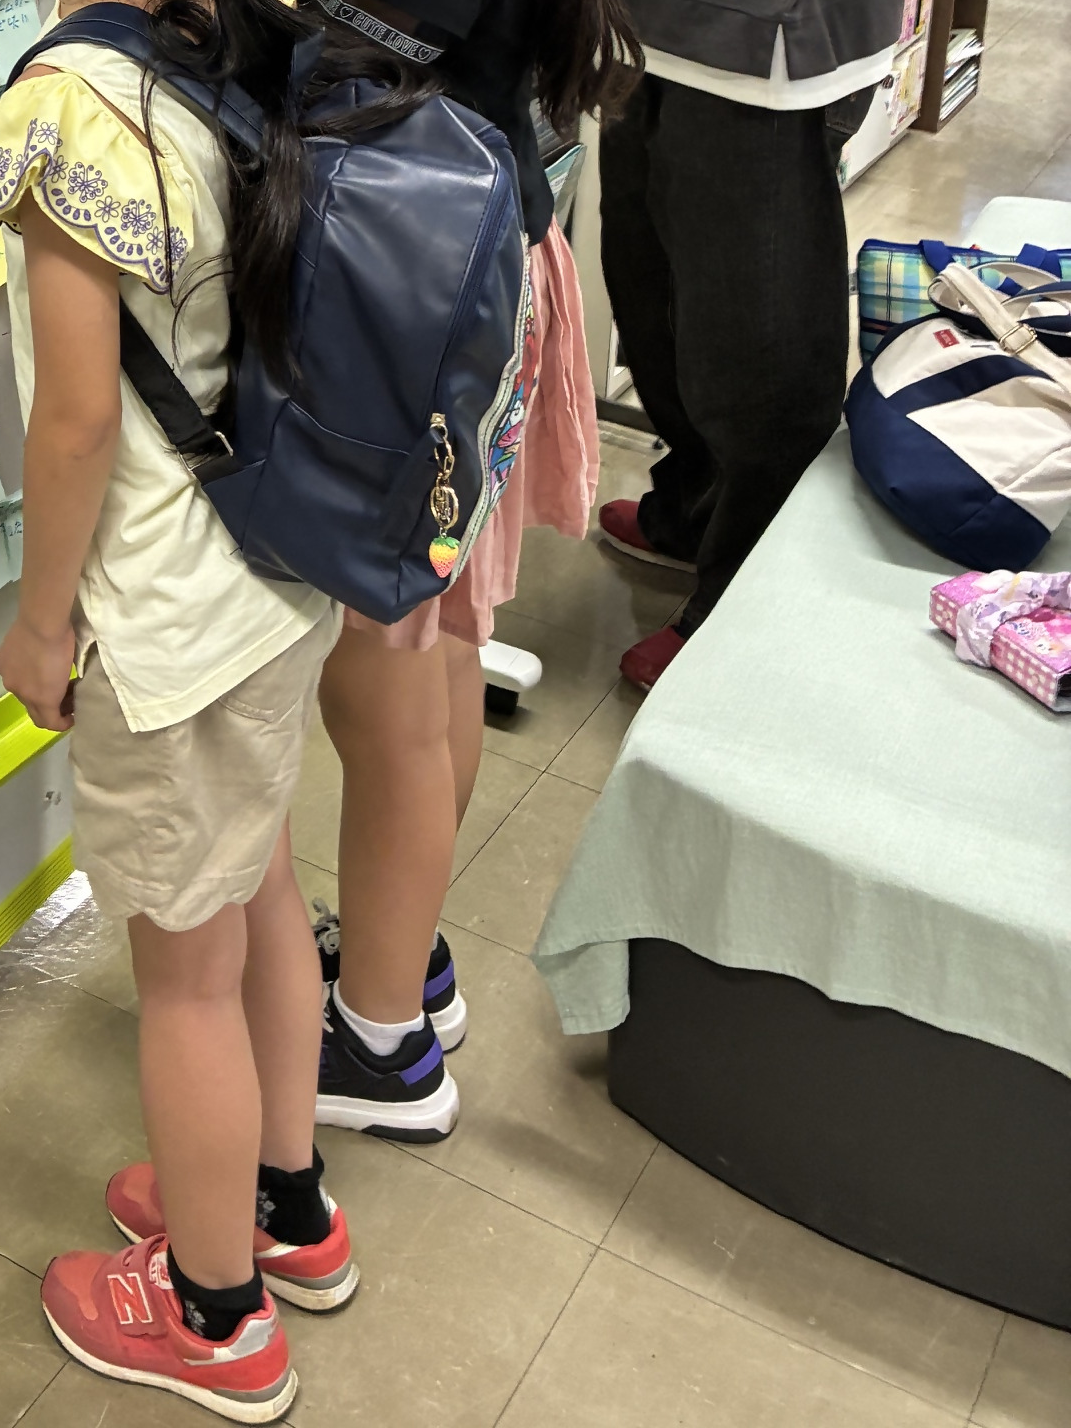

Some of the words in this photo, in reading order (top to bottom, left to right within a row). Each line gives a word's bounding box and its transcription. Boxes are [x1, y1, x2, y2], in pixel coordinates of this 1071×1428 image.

[353, 11, 386, 41] CUTE
[386, 31, 419, 57] LOVE
[107, 1272, 153, 1326] N
